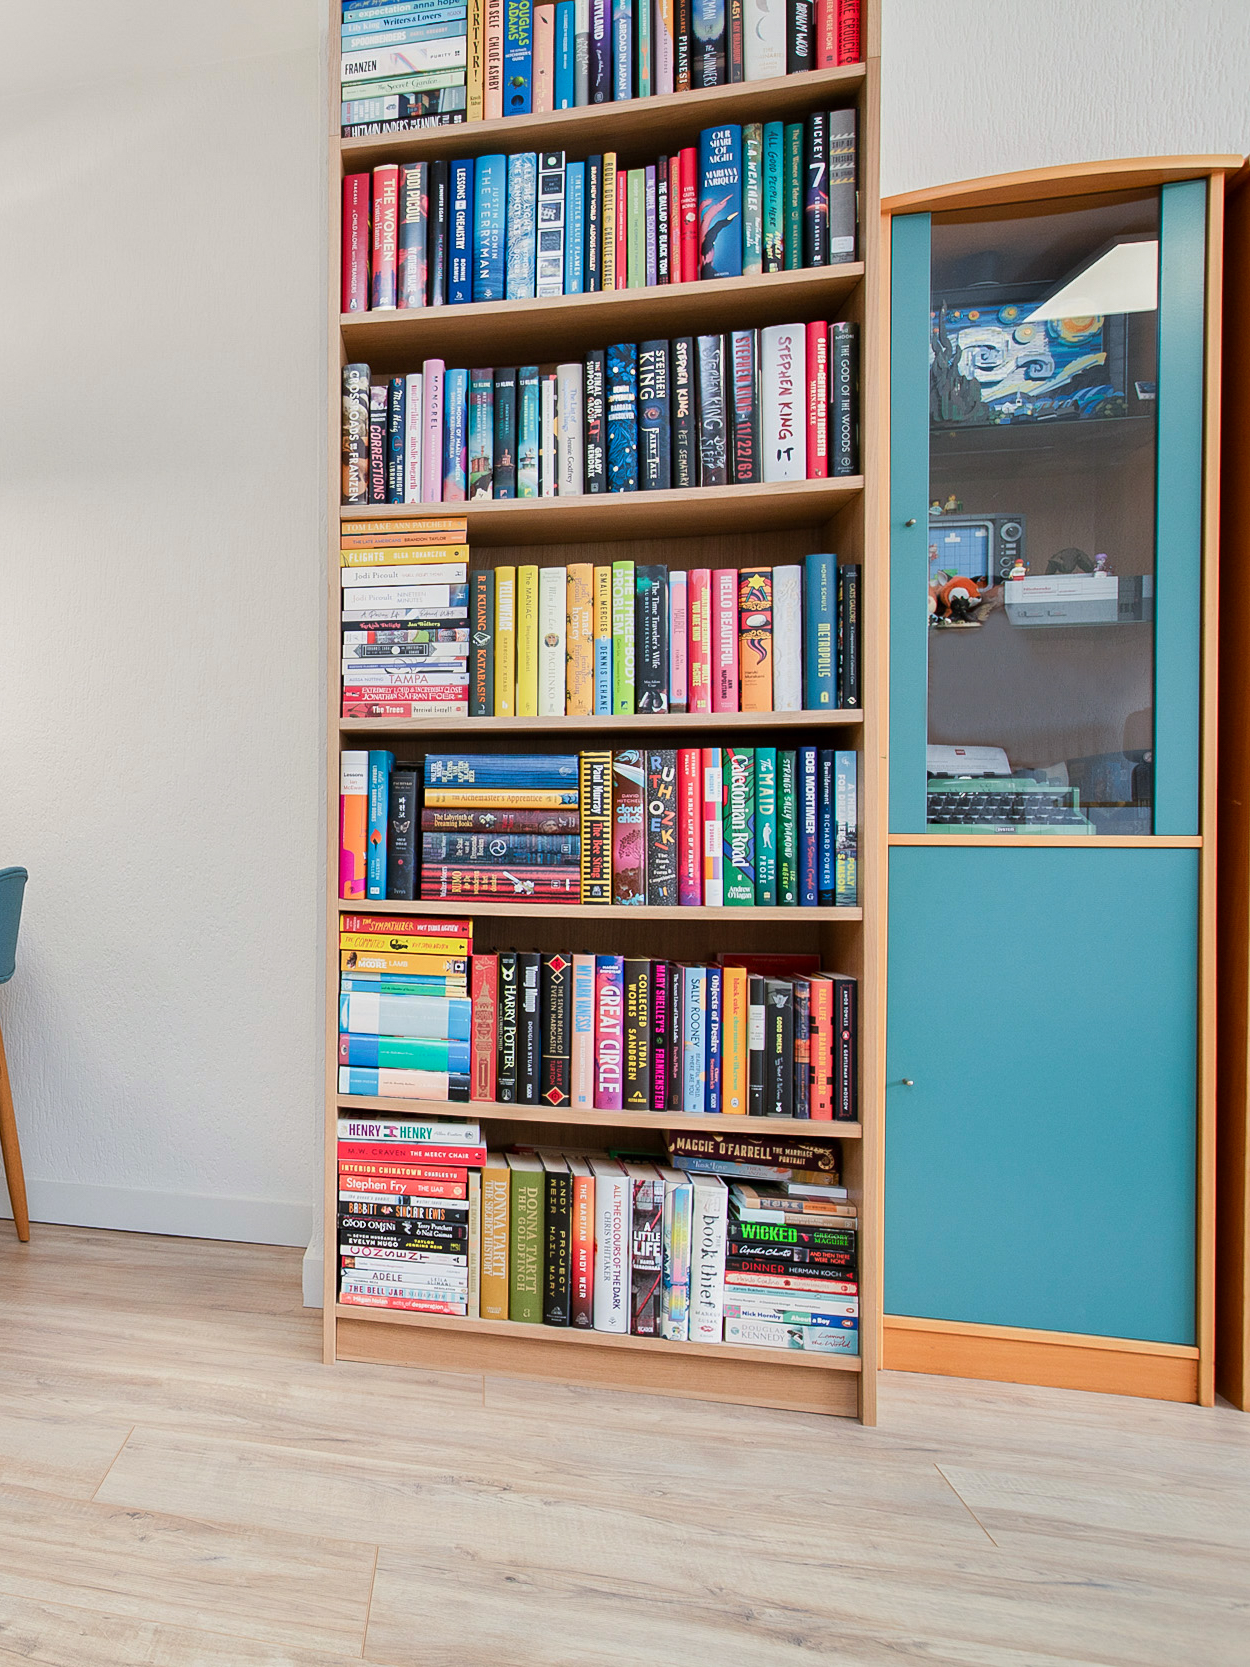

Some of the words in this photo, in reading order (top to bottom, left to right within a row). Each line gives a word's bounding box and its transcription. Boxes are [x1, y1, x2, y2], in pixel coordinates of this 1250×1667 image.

[359, 4, 411, 17] expectation
[384, 16, 411, 26] Writers
[417, 13, 442, 21] Lovers
[508, 2, 519, 40] ADAMS
[351, 31, 406, 47] SPOONBENDERS
[619, 18, 627, 53] ABROAD
[345, 60, 377, 75] FRANZEN
[619, 53, 627, 62] IN
[679, 36, 687, 84] PIRANESI
[704, 52, 717, 87] WINNERS
[619, 62, 627, 90] JAPAN
[710, 137, 732, 148] SHARE
[814, 117, 822, 159] MICKEY
[709, 153, 733, 164] NIGHT
[457, 168, 466, 199] LESSONS
[481, 168, 491, 194] THE
[659, 182, 667, 194] THE
[809, 162, 826, 188] 7
[384, 179, 395, 204] THE
[659, 196, 667, 221] BALLAD
[384, 208, 395, 261] WOMEN
[456, 211, 465, 249] CHEMISTRY
[480, 203, 491, 279] FERRYMAN
[659, 223, 667, 233] OF
[659, 235, 667, 257] BLACK
[675, 342, 688, 386] STEPHEN
[735, 337, 751, 383] STEPHEN
[841, 345, 850, 357] THE
[640, 351, 655, 400] KING
[656, 350, 665, 398] STEPHEN
[778, 336, 792, 396] STEPHEN
[841, 360, 850, 382] GOD
[430, 376, 438, 429] MONGREL
[677, 389, 689, 418] KING
[736, 386, 751, 412] KING
[841, 385, 850, 395] OF
[841, 397, 850, 411] THE
[349, 370, 360, 440] CROSSROADS
[778, 402, 793, 440] KING
[841, 415, 850, 452] WOODS
[370, 425, 385, 499] CORRECTIONS
[737, 421, 752, 479] 11/22/63
[776, 446, 794, 462] IT
[349, 453, 359, 501] FRANZEN
[349, 552, 384, 562] FLIGHTS
[478, 575, 486, 583] R.
[625, 571, 634, 593] THE
[651, 581, 659, 594] The
[720, 575, 732, 607] HELLO
[478, 595, 486, 631] KUANG
[499, 580, 512, 632] YELLOWFACE
[613, 569, 623, 635] PROBLEM
[651, 595, 659, 612] Time
[625, 595, 634, 686] THREE-BODY
[721, 609, 733, 667] BEAUTIFUL
[817, 623, 831, 677] METROPOLIS
[652, 652, 660, 669] Wife
[389, 674, 428, 684] TAMPA
[478, 650, 486, 703] KATABASIS
[593, 765, 603, 787] Paul
[760, 759, 773, 772] The
[805, 751, 815, 773] BOB
[461, 794, 505, 802] Alchemaster's
[506, 794, 542, 803] Apprentice
[593, 789, 603, 814] Murray
[731, 755, 749, 829] Caledonian
[758, 774, 774, 815] MAID
[805, 776, 816, 834] MORTIMER
[617, 804, 643, 815] cloud
[591, 822, 602, 837] The
[591, 839, 602, 855] Bee
[731, 832, 749, 868] Road
[591, 856, 603, 879] Sting
[728, 886, 751, 894] Andrew
[728, 892, 752, 900] O'Hagan
[576, 965, 592, 974] MY
[656, 965, 665, 987] MARY
[576, 976, 591, 999] DARK
[628, 984, 636, 1017] WORKS
[638, 974, 647, 1027] COLLECTED
[691, 978, 700, 1005] SALLY
[711, 975, 719, 1005] Objects
[505, 985, 516, 1024] HARRY
[575, 1000, 591, 1033] VANESSA
[599, 986, 620, 1035] GREAT
[655, 989, 665, 1033] SHELLEY'S
[711, 1007, 719, 1017] of
[691, 1008, 700, 1047] ROONEY
[711, 1019, 719, 1053] Desire
[504, 1026, 516, 1070] POTTER
[628, 1028, 636, 1081] SANDGREN
[638, 1041, 646, 1069] LYDIA
[599, 1039, 620, 1093] CIRCLE
[655, 1048, 664, 1109] FRANKENSTEIN
[349, 1124, 381, 1137] HENRY
[400, 1126, 433, 1140] HENRY
[372, 1148, 406, 1156] CRAVEN
[677, 1137, 714, 1153] MAGGIE
[719, 1142, 772, 1160] O'FARRELL
[346, 1178, 387, 1191] Stephen
[390, 1180, 406, 1194] Fry
[495, 1180, 506, 1230] DONNA
[527, 1187, 538, 1241] DONNA
[633, 1231, 661, 1244] LITTLE
[643, 1222, 651, 1231] A
[701, 1214, 720, 1263] book
[741, 1223, 797, 1243] WICKED
[495, 1233, 506, 1279] TARTT
[633, 1241, 660, 1257] LIFE
[526, 1245, 538, 1294] TARTT
[742, 1261, 785, 1274] DINNER
[700, 1264, 717, 1309] thief
